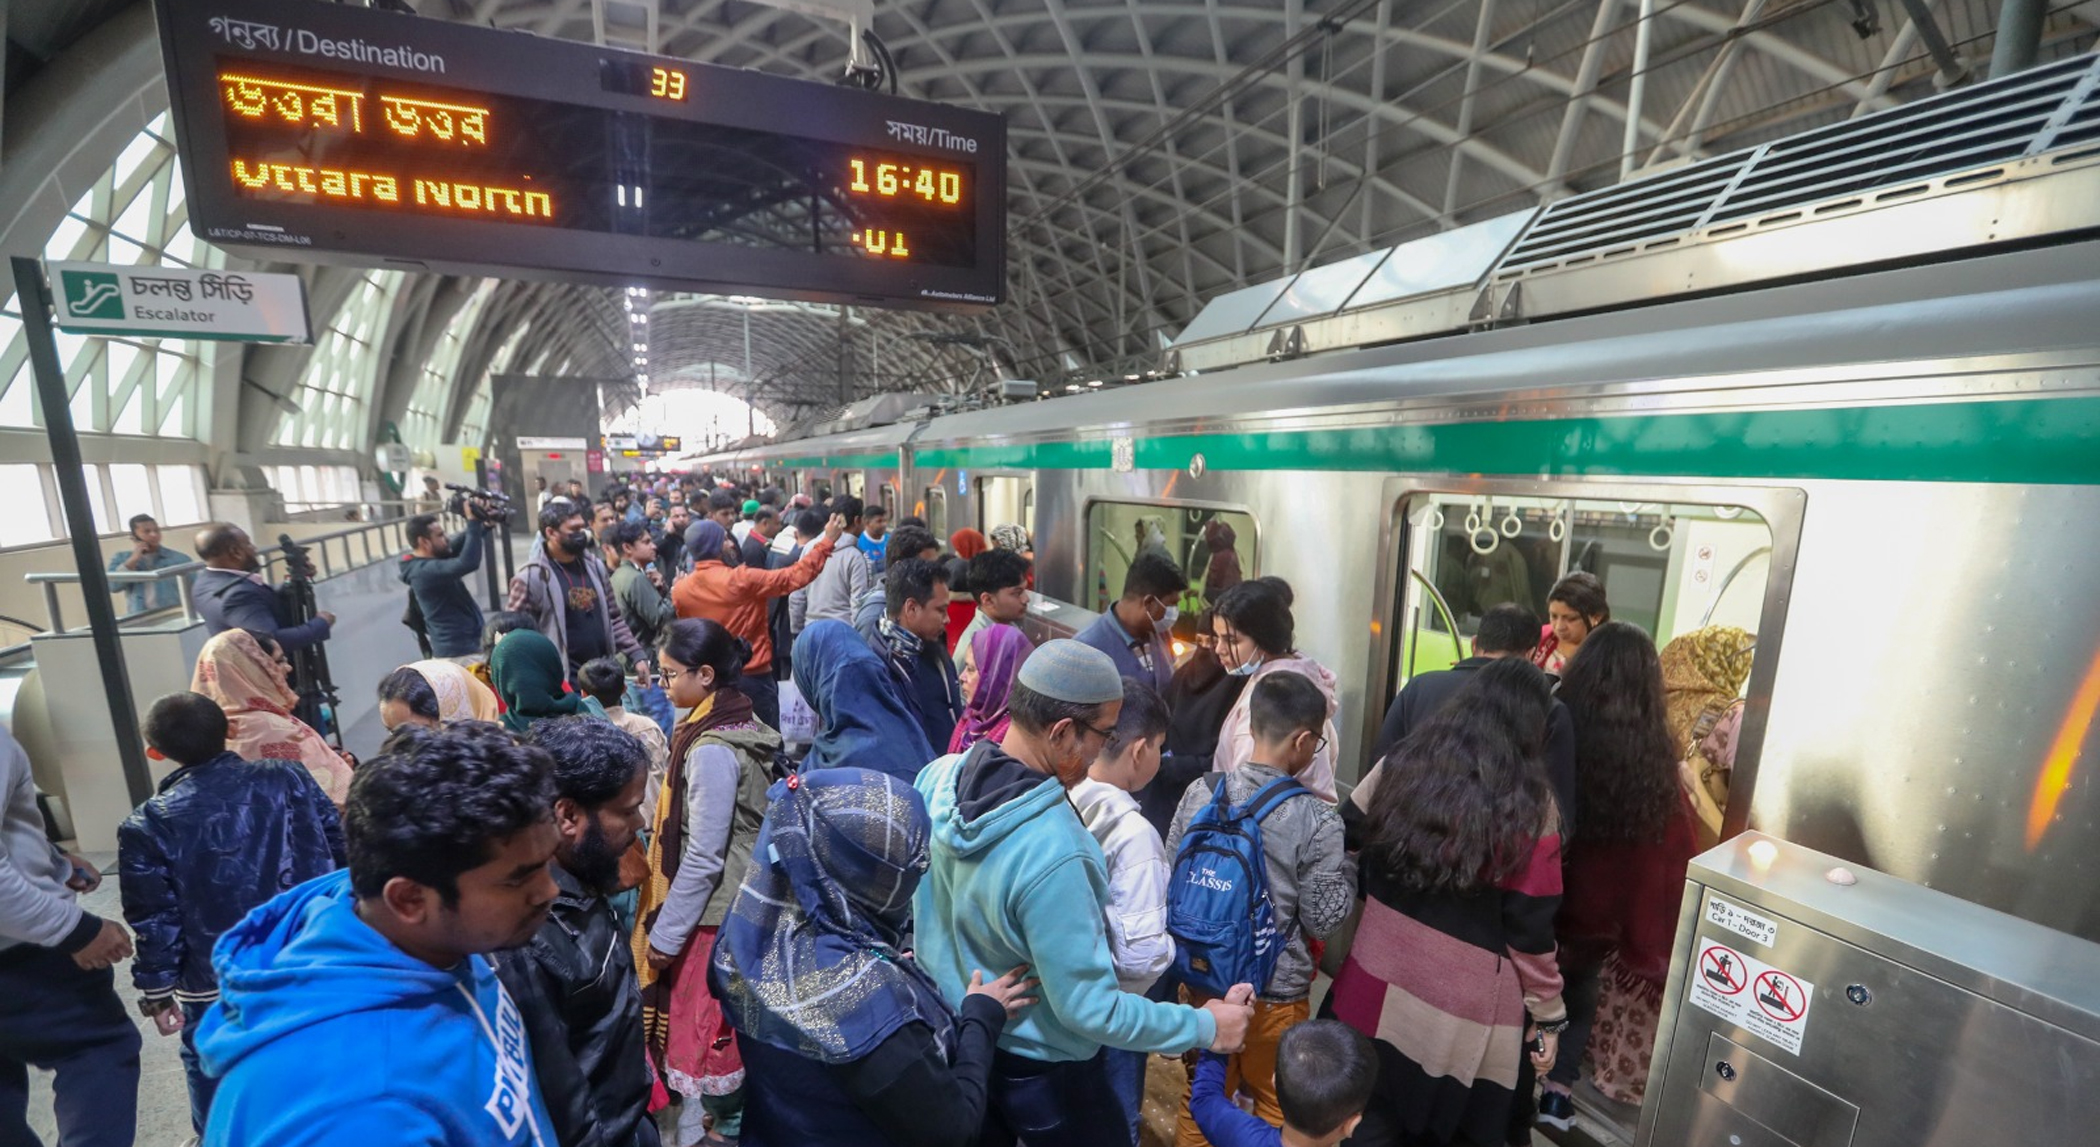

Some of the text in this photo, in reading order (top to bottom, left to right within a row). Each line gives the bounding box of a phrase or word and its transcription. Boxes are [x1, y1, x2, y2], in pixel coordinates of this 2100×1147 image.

[651, 67, 687, 101] 33
[232, 159, 398, 202] Uttara
[850, 157, 961, 204] 16:40
[129, 276, 193, 302] চলন্ত
[134, 305, 217, 323] Escalator
[1712, 912, 1725, 924] Car
[1739, 924, 1760, 939] Door
[1761, 934, 1768, 942] 3
